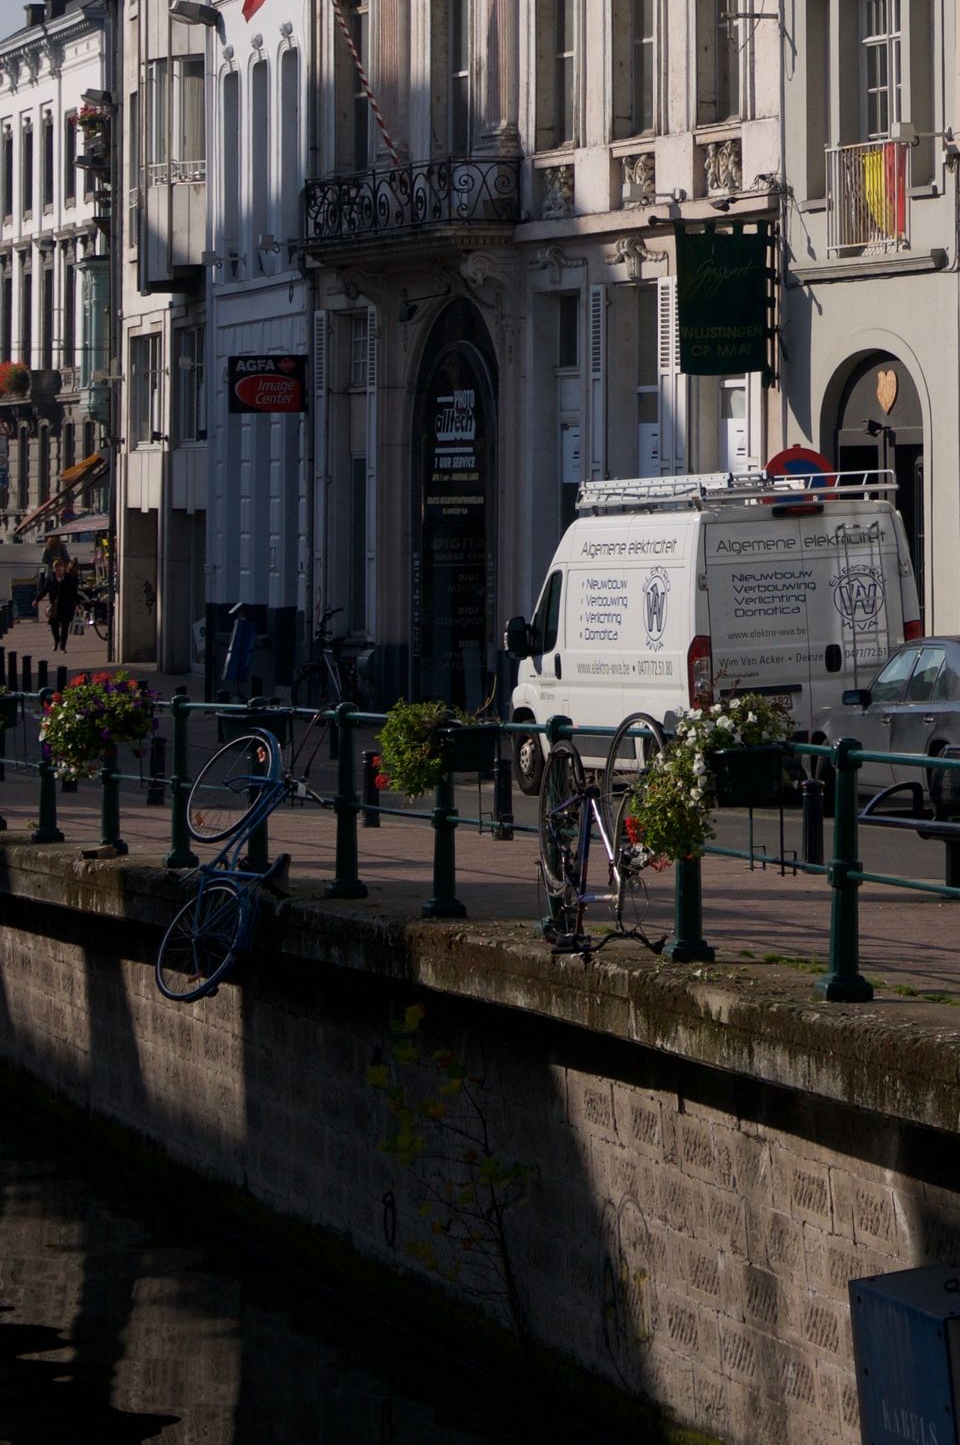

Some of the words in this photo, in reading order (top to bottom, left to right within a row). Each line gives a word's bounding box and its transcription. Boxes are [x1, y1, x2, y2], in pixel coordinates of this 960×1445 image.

[691, 344, 711, 357] OP
[717, 343, 752, 357] MAAT
[235, 359, 276, 372] AGFA
[258, 379, 295, 394] Image
[255, 392, 294, 405] Center
[454, 389, 475, 408] PHOTO
[452, 456, 476, 469] SERVICE
[581, 541, 626, 559] Algemene
[628, 538, 677, 555] elektriciteit
[716, 538, 796, 554] Algemene
[731, 570, 813, 583] Nieuwbouw
[586, 578, 628, 591] Nieuwbouw
[733, 581, 816, 594] Verbouwing
[585, 595, 628, 609] Verbouwing
[734, 594, 807, 606] Verlichting
[734, 605, 801, 618] Domotica
[584, 612, 622, 626] Verlichting
[584, 628, 618, 641] Domotica
[727, 627, 806, 639] www.elektro-wva.be
[719, 657, 739, 667] Wim
[741, 656, 757, 666] Van
[759, 655, 785, 665] Acker
[796, 652, 824, 663] Deinze
[577, 661, 630, 676] www.elektro-wva.be
[637, 660, 673, 676] 0477/72.51.80
